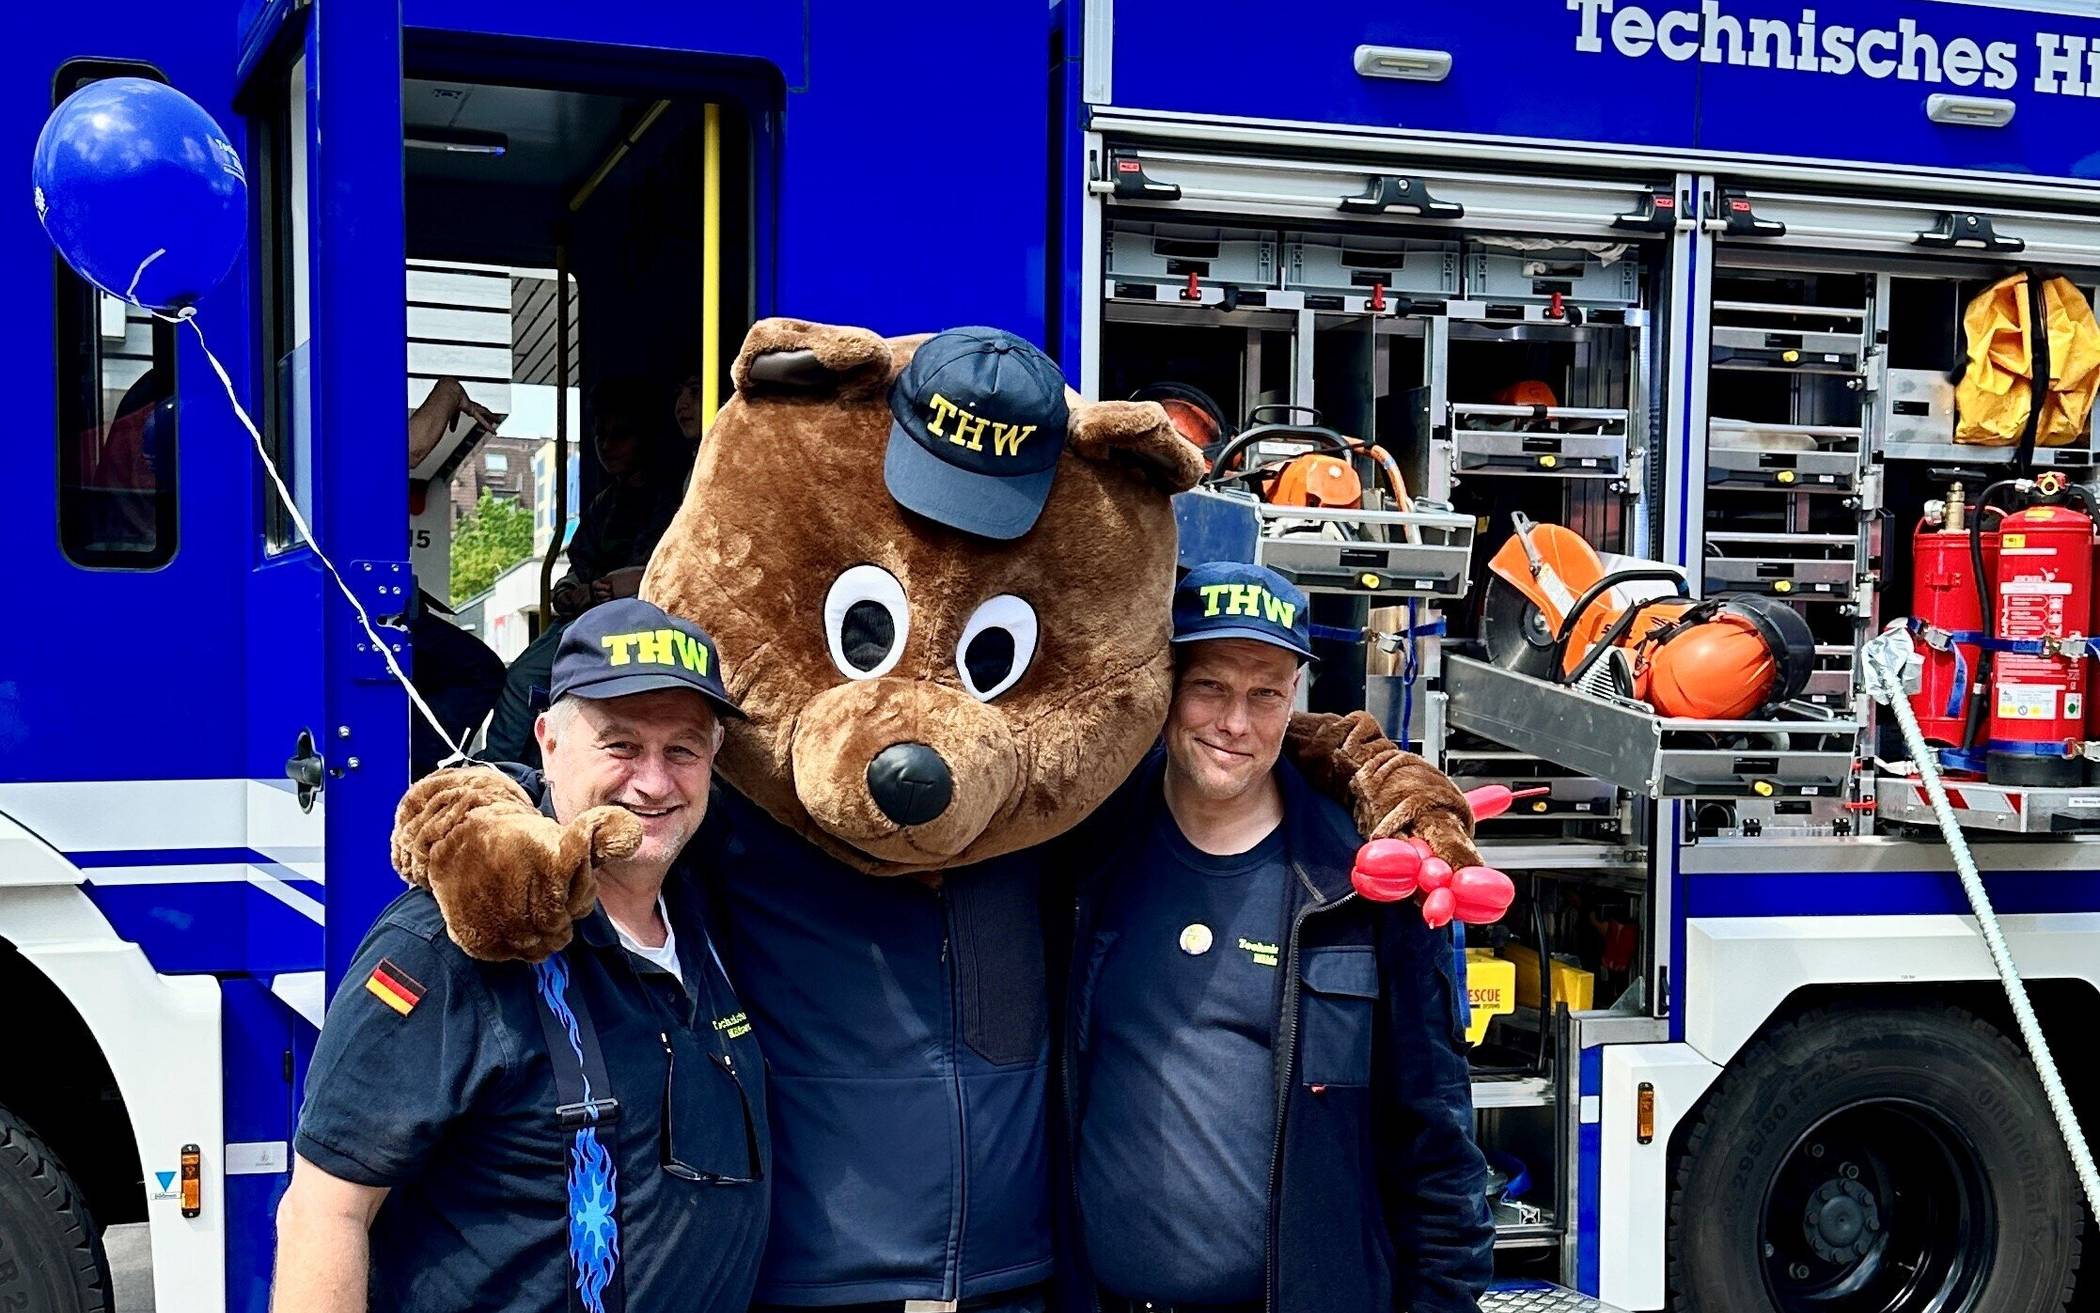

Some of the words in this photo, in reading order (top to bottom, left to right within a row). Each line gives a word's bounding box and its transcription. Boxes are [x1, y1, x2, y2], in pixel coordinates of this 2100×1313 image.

[1567, 0, 2017, 90] Technisches
[927, 393, 1037, 456] THW
[1200, 584, 1296, 629] THW
[601, 629, 708, 677] THW
[1468, 988, 1500, 1002] ESCUE
